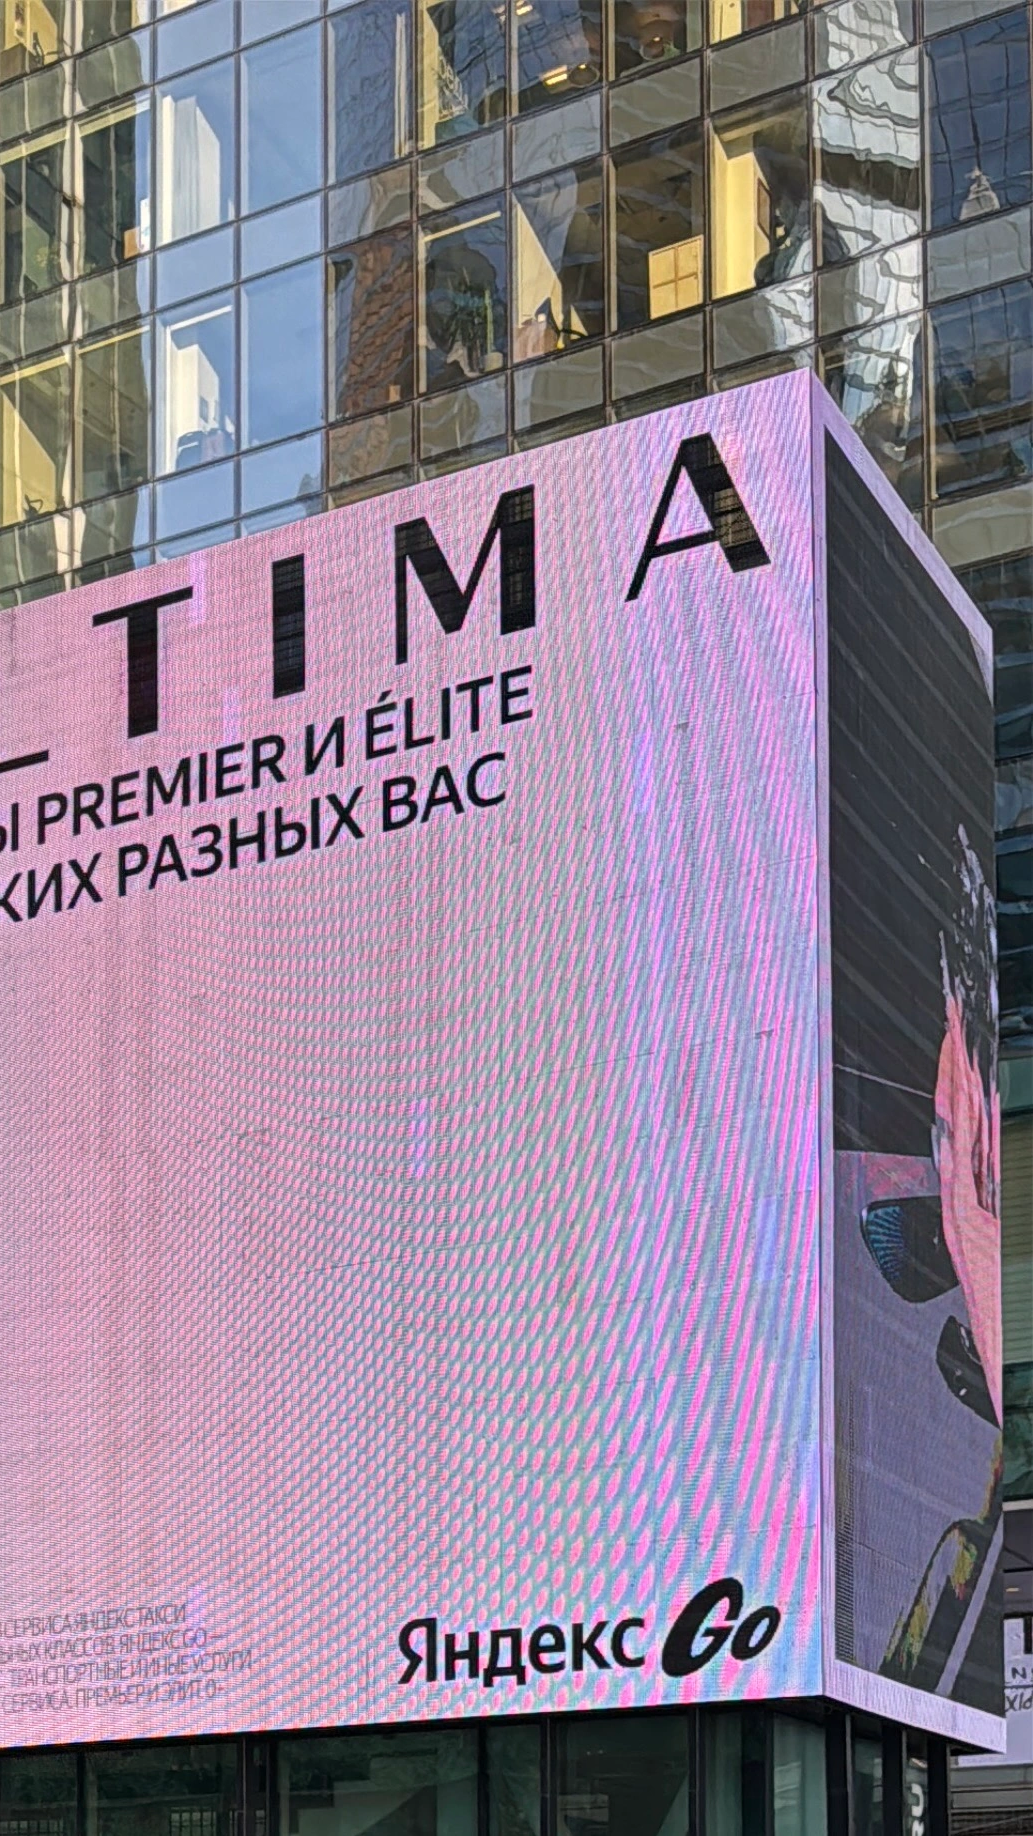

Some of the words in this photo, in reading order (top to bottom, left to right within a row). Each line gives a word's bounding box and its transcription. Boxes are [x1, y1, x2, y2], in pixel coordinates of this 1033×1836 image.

[37, 734, 286, 844] PREMIER
[305, 716, 345, 776] И
[365, 666, 533, 760] ÉLITE
[118, 786, 365, 897] РАЗНЫХ
[382, 752, 507, 832] ВАС
[398, 1618, 645, 1687] Яндекс
[662, 1578, 780, 1677] Go
